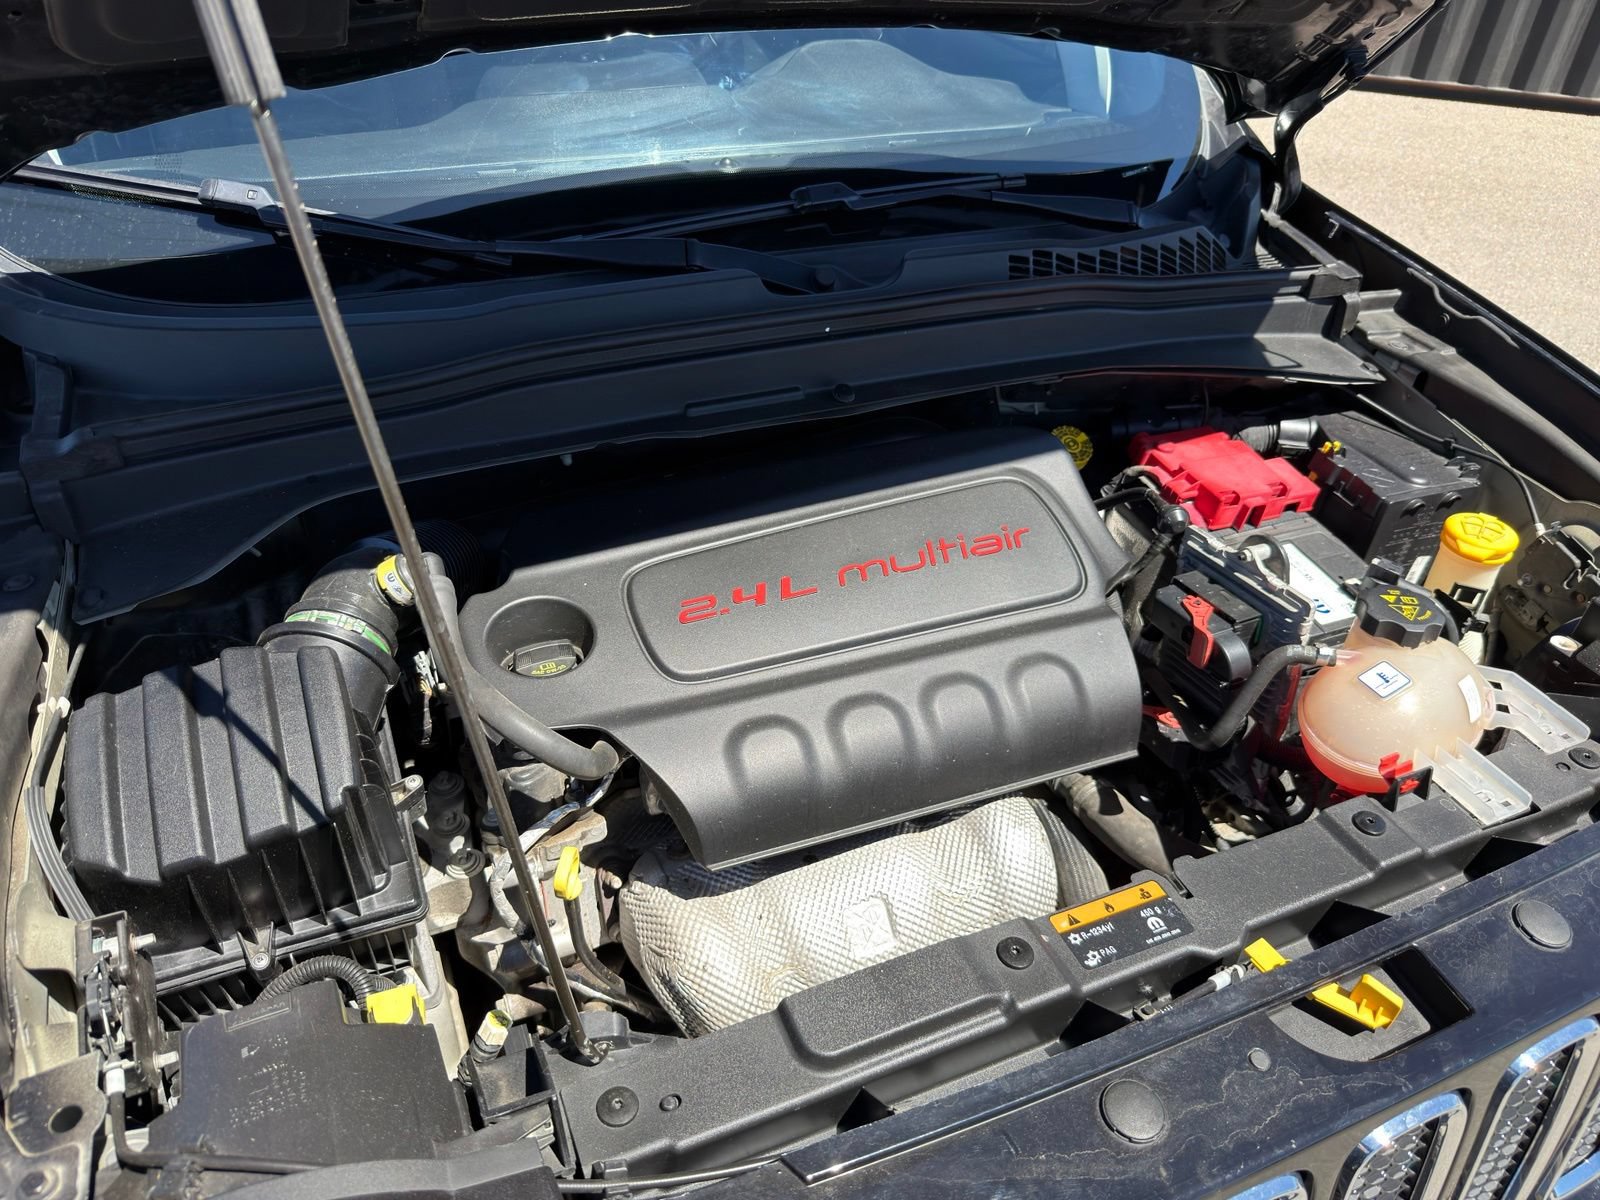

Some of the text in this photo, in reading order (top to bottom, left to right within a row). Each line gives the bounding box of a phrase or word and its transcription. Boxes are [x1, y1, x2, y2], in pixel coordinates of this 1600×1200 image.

[678, 523, 1030, 625] 2.4 L multiair
[1099, 945, 1117, 958] PAG
